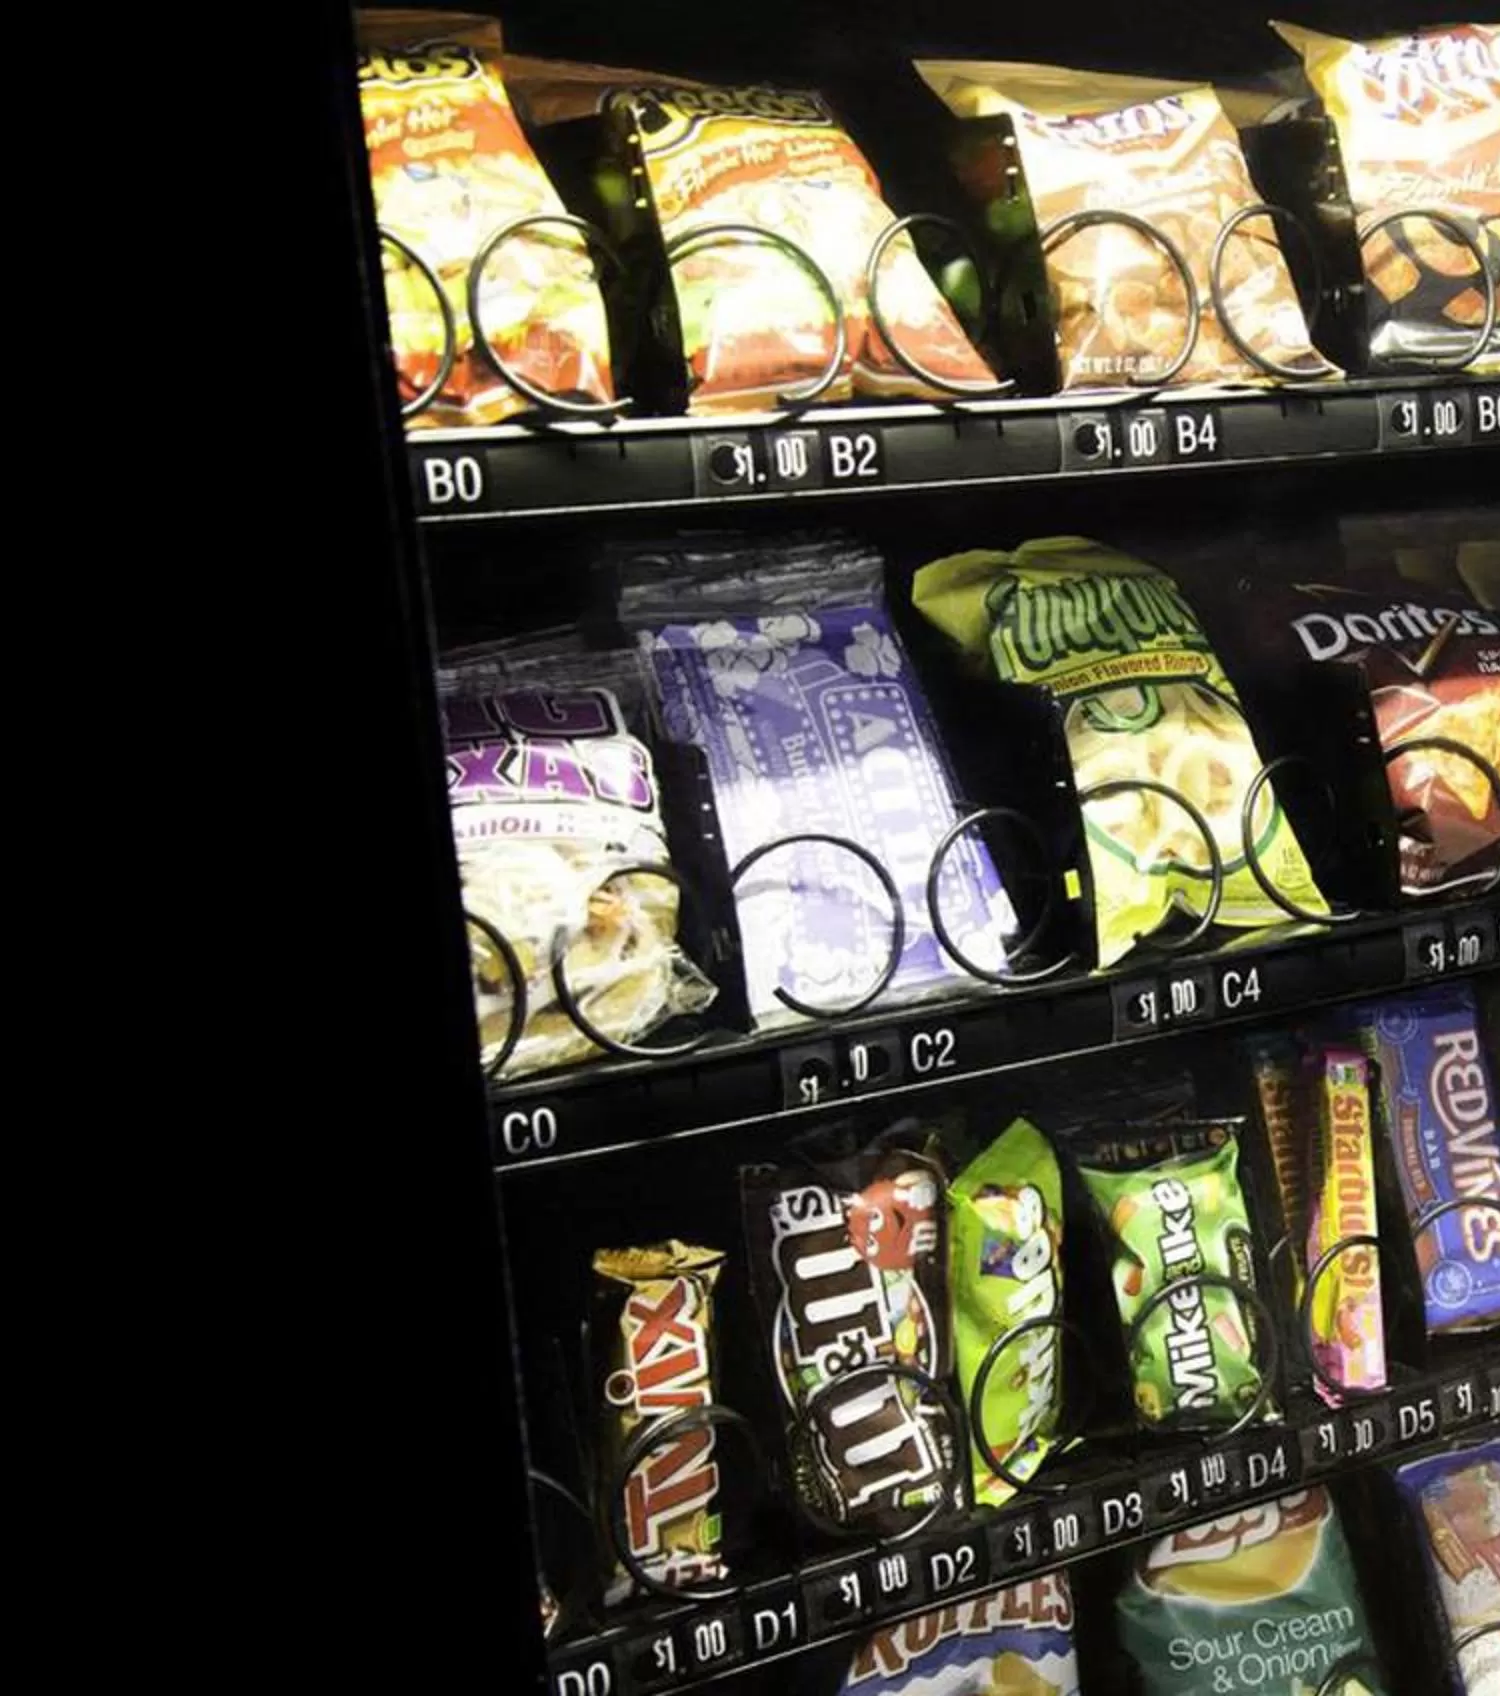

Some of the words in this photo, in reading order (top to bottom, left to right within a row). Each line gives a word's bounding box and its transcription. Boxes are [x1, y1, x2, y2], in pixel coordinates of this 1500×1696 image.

[830, 434, 879, 478] B2
[1176, 414, 1217, 453] B4
[425, 456, 483, 502] B0
[1291, 603, 1500, 661] Doritos
[1092, 654, 1161, 680] Flavored
[1222, 966, 1262, 1009] C4
[910, 1029, 956, 1073] C2
[503, 1106, 557, 1154] C0
[1331, 1092, 1375, 1290] Starbust
[1152, 1178, 1199, 1266] Ike
[1166, 1279, 1217, 1408] Mike
[1400, 1399, 1435, 1440] D5
[1248, 1446, 1288, 1488] D4
[1102, 1491, 1144, 1535] D3
[931, 1545, 977, 1591] D2
[754, 1601, 798, 1650] D1
[1168, 1631, 1244, 1671] Sour
[1252, 1605, 1354, 1648] Cream
[1212, 1665, 1235, 1694] &
[1238, 1642, 1330, 1687] Onion
